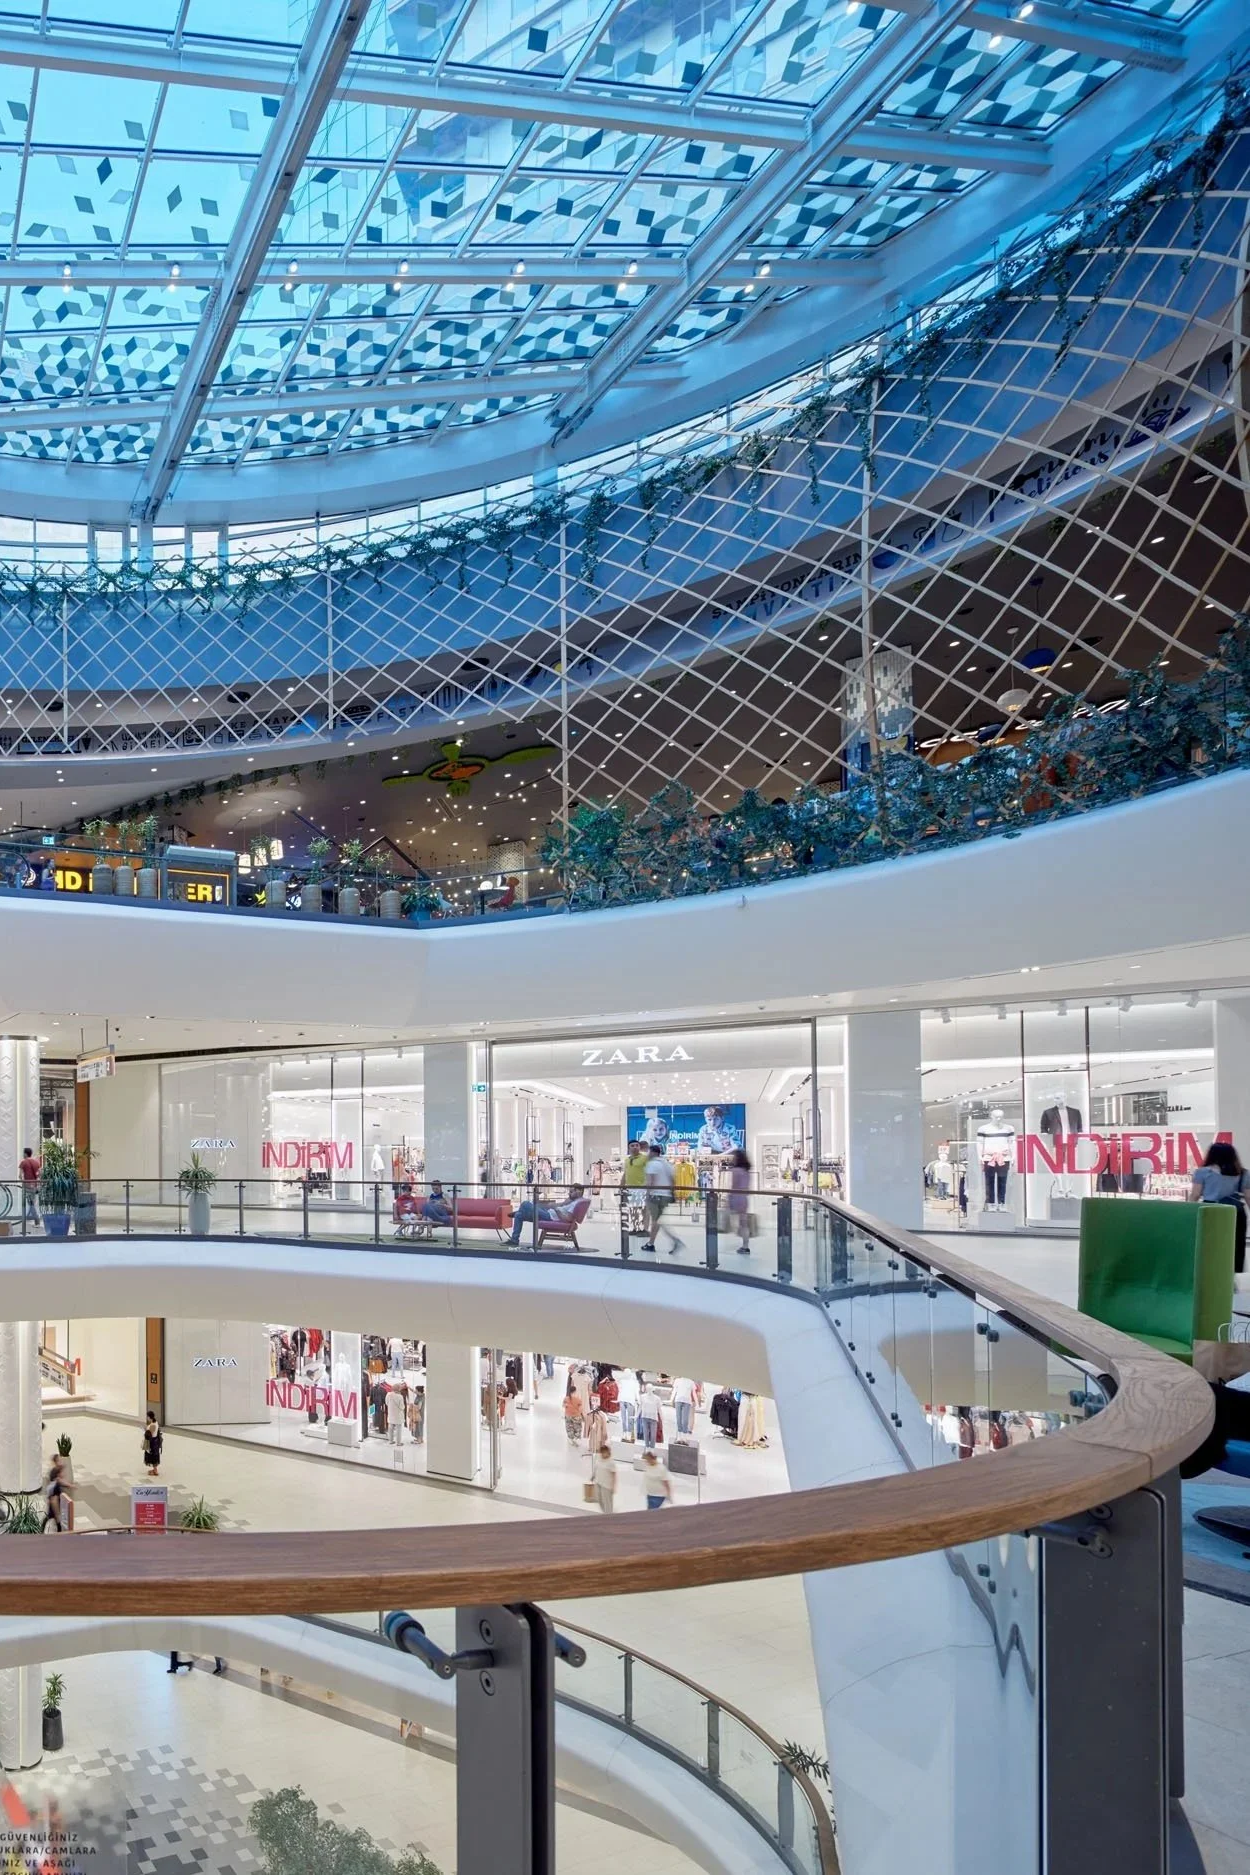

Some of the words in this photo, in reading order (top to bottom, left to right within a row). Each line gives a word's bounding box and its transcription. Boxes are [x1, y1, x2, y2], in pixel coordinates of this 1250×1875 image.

[581, 1045, 695, 1066] ZARA
[190, 1137, 237, 1149] ZARA
[193, 1356, 238, 1367] ZARA
[0, 1832, 78, 1842] GÜVENLİĞİNİZ
[24, 1859, 40, 1868] VE
[42, 1857, 76, 1869] AŞAĞI
